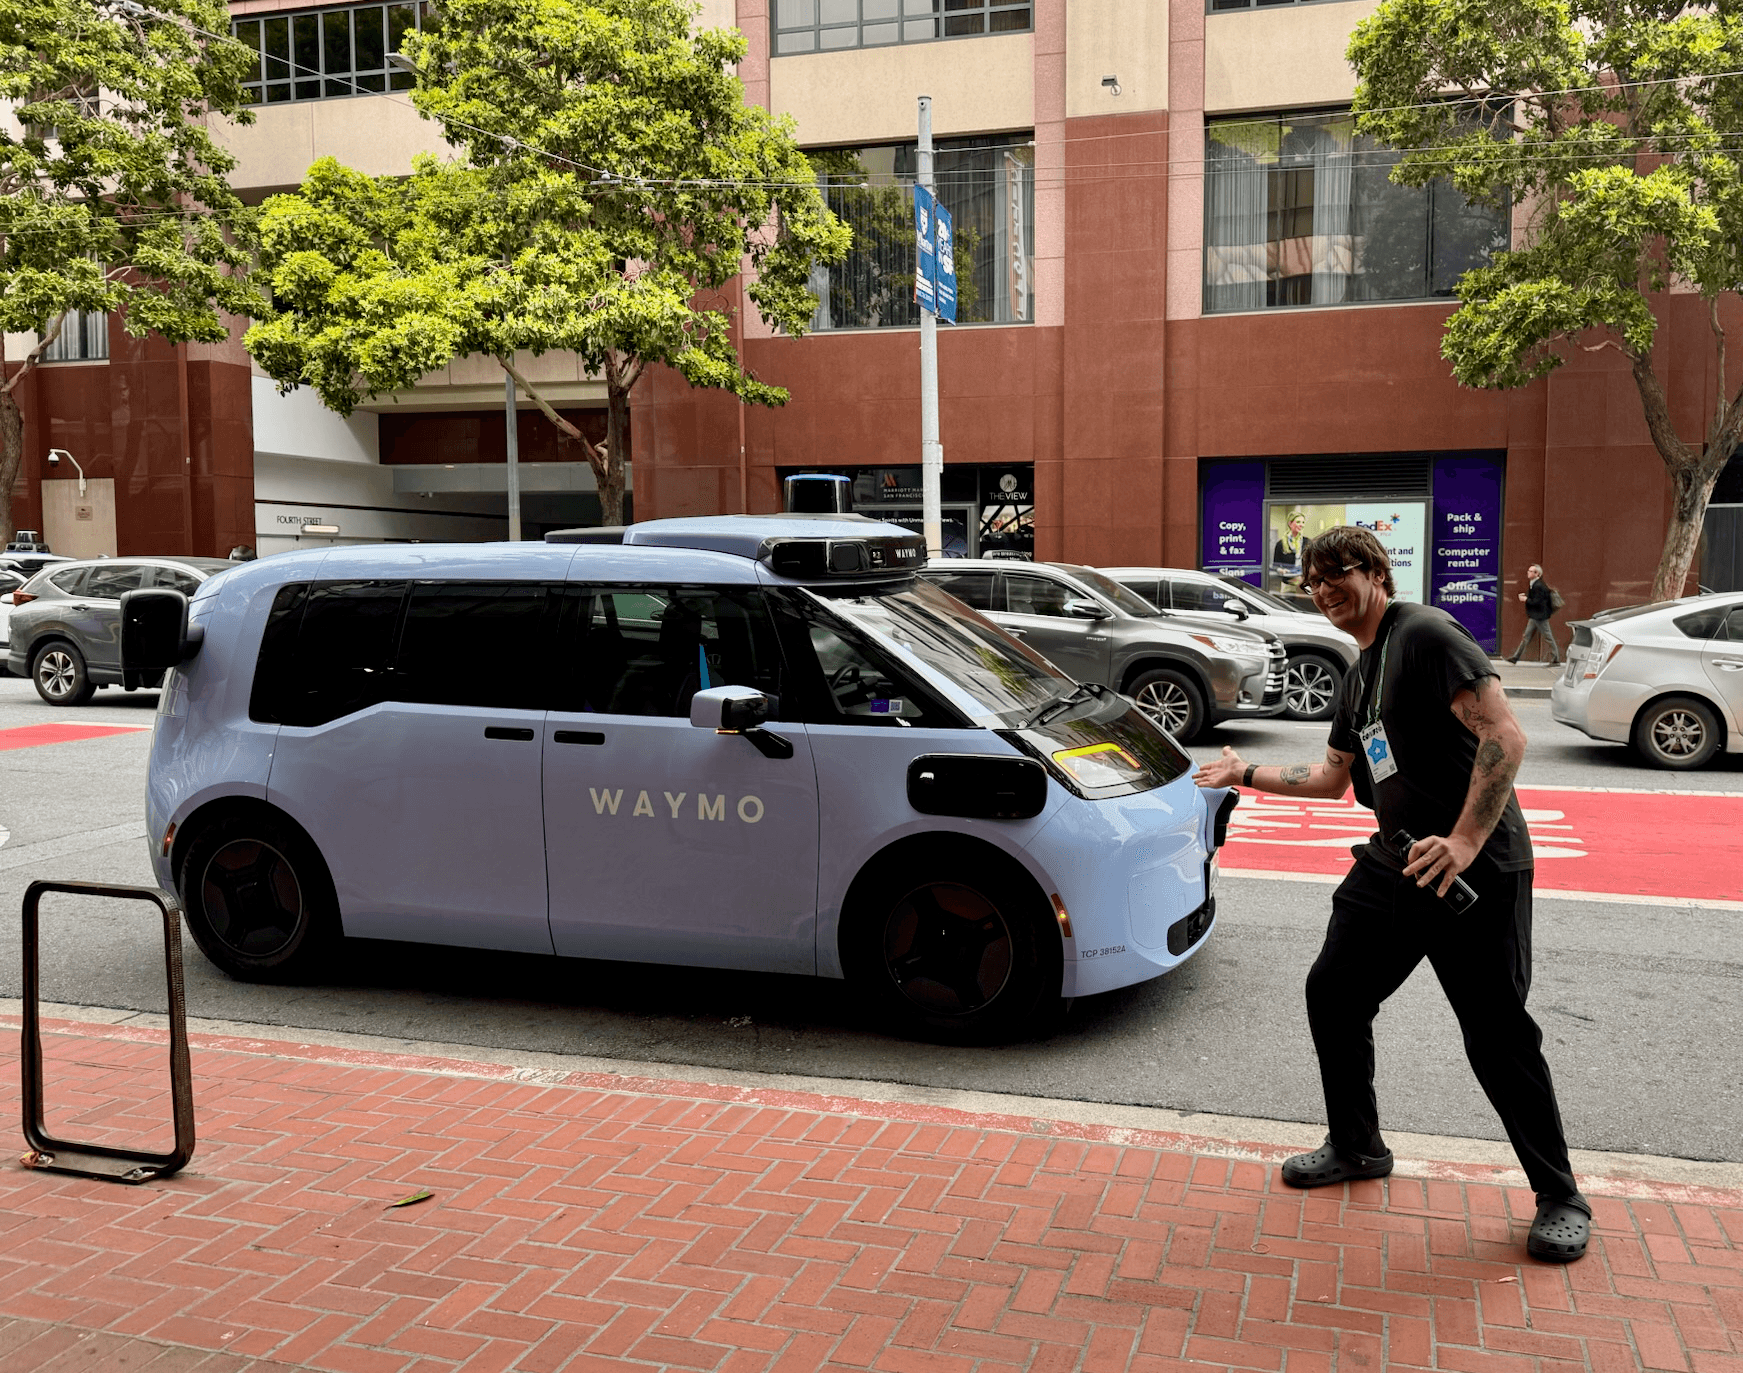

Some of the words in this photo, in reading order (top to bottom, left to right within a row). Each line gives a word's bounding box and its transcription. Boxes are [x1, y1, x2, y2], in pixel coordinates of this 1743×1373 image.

[989, 491, 1005, 501] THE
[1005, 491, 1028, 501] VIEW
[276, 515, 301, 525] FOURTH
[302, 517, 322, 525] STREET
[1446, 513, 1471, 522] Pack
[1473, 513, 1482, 522] &
[1219, 521, 1247, 532] Copy,
[1453, 524, 1475, 535] ship
[1219, 534, 1247, 545] print,
[895, 548, 916, 558] WAYMO
[1219, 546, 1228, 555] &
[1229, 546, 1246, 555] fax
[1398, 546, 1414, 555] and
[1438, 547, 1490, 559] Computer
[1391, 558, 1412, 567] tions
[1447, 559, 1479, 568] rental
[1219, 567, 1245, 577] Signs
[1447, 582, 1479, 591] Office
[1441, 593, 1484, 603] supplies
[589, 787, 764, 824] WAYMO
[1081, 949, 1098, 958] TCP
